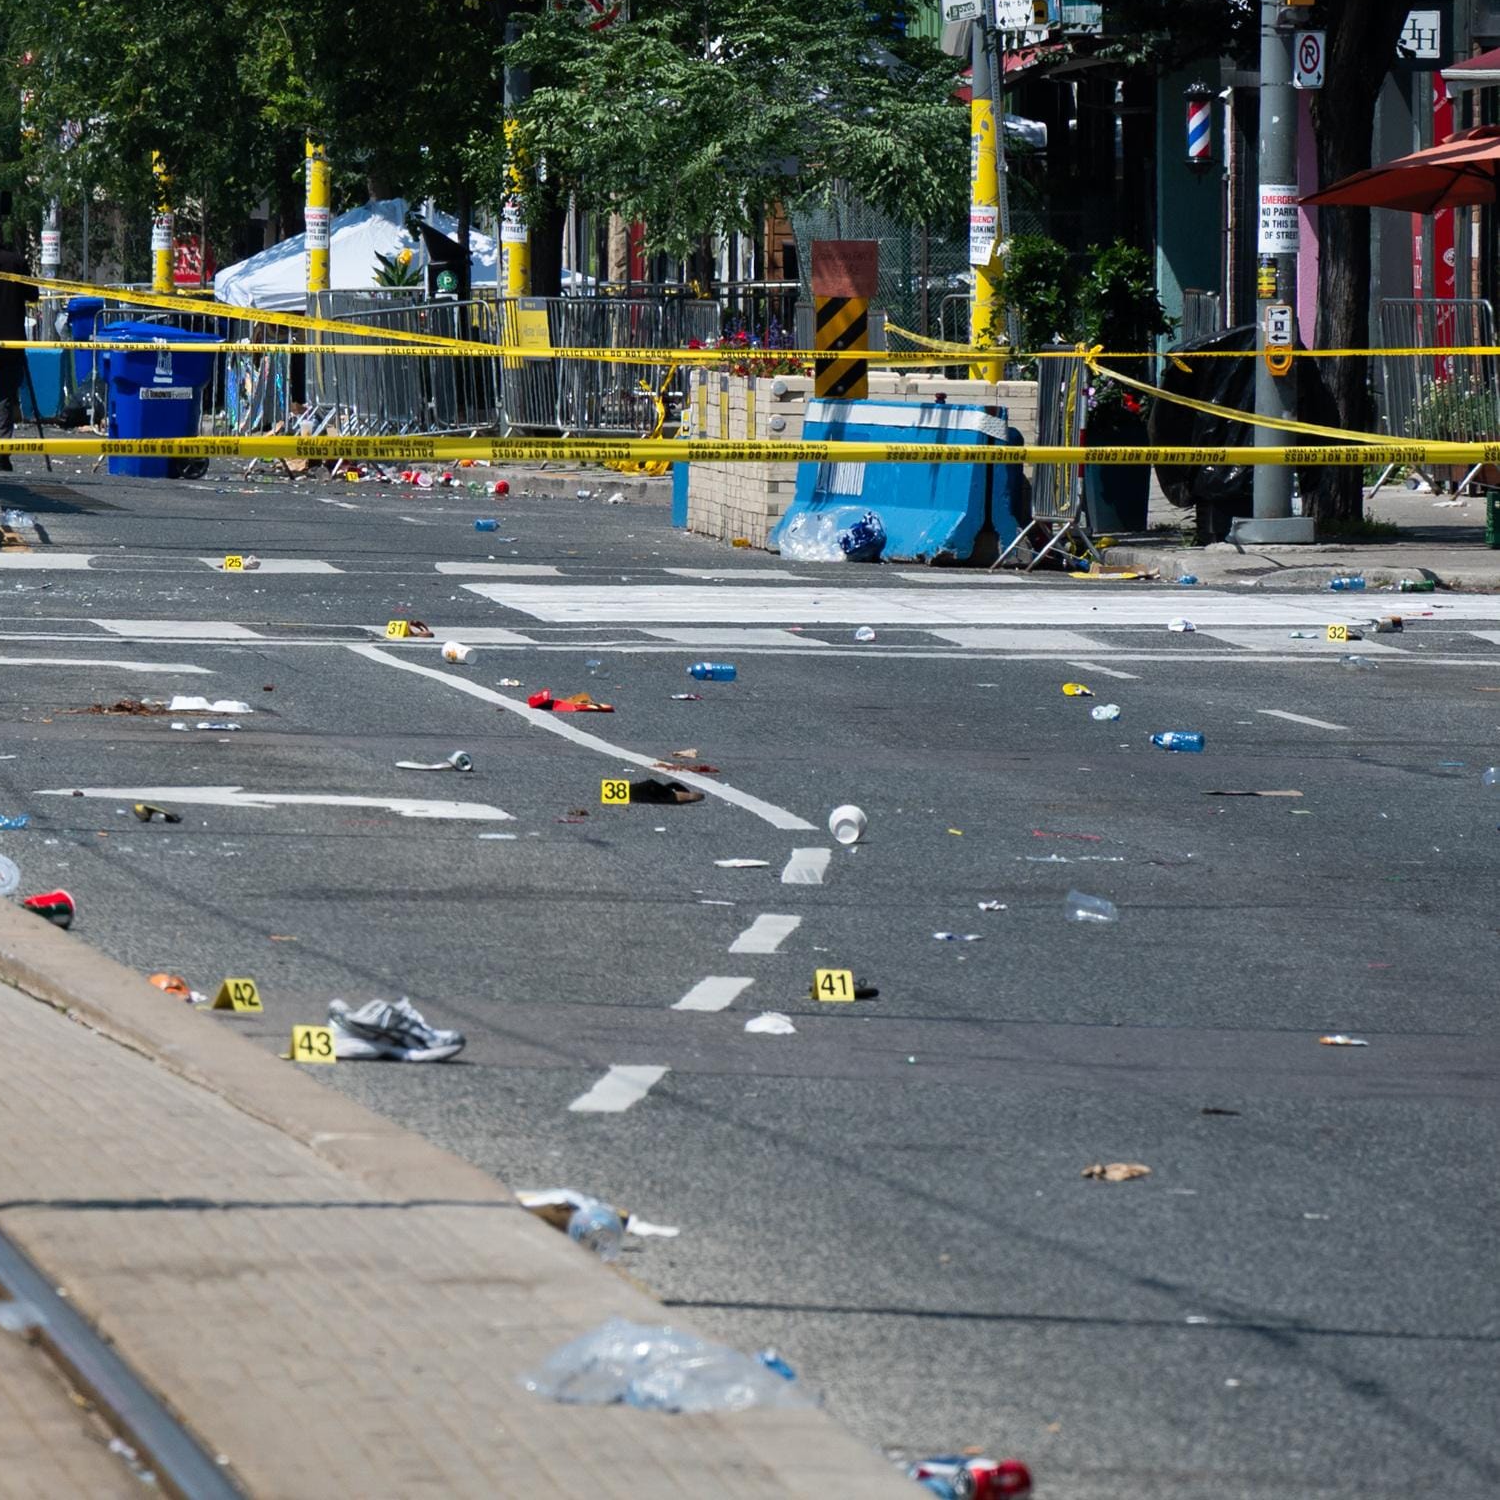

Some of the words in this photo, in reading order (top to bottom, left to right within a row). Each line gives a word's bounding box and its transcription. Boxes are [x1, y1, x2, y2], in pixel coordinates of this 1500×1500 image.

[1262, 208, 1271, 216] NO
[1272, 219, 1288, 228] THIS
[150, 390, 171, 399] TORONTO
[101, 444, 133, 454] CROSS
[138, 444, 156, 454] NOT
[161, 444, 173, 454] DO
[179, 445, 199, 455] LINE
[204, 445, 239, 455] POLICE
[297, 446, 328, 456] CROSS
[333, 447, 352, 456] NOT
[356, 447, 368, 456] DO
[374, 448, 394, 457] LINE
[400, 448, 434, 458] POLICE
[492, 449, 523, 458] CROSS
[529, 449, 547, 459] NOT
[552, 449, 564, 459] DO
[570, 449, 590, 459] LINE
[596, 450, 630, 459] POLICE
[689, 450, 720, 460] CROSS
[725, 451, 744, 460] NOT
[748, 451, 761, 460] DO
[766, 451, 787, 460] LINE
[793, 451, 828, 460] POLICE
[888, 452, 918, 460] CROSS
[923, 452, 941, 460] NOT
[946, 452, 960, 460] DO
[965, 452, 985, 460] LINE
[991, 452, 1026, 460] POLICE
[1085, 452, 1117, 461] CROSS
[1122, 452, 1141, 461] NOT
[1146, 453, 1158, 462] DO
[1164, 453, 1185, 462] LINE
[1191, 454, 1225, 462] POLICE
[1285, 454, 1317, 462] CROSS
[1322, 453, 1340, 462] NOT
[1346, 453, 1358, 462] DO
[1363, 453, 1384, 462] LINE
[1390, 452, 1425, 462] POLICE
[228, 558, 241, 567] 25
[388, 623, 402, 634] 31
[1329, 627, 1344, 638] 32
[604, 783, 627, 799] 38
[821, 973, 846, 996] 41
[233, 984, 257, 1006] 42
[299, 1032, 331, 1055] 43
